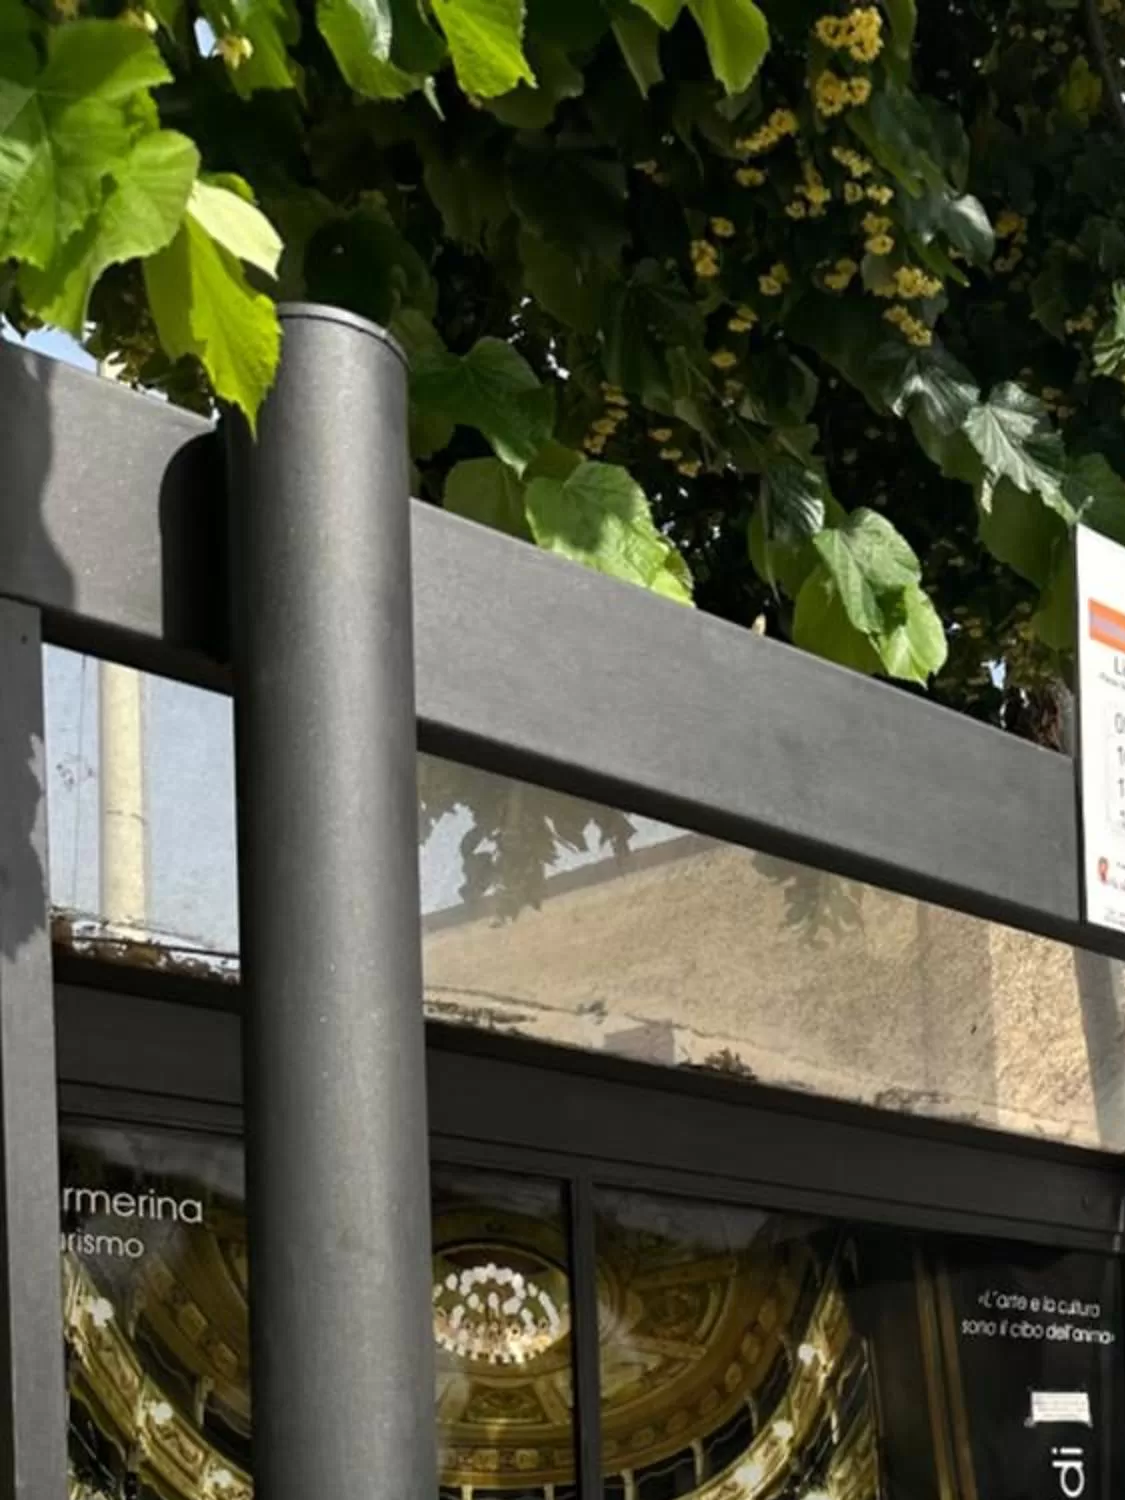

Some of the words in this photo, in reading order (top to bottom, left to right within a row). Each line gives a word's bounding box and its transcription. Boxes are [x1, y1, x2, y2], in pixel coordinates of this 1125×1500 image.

[1030, 1298, 1040, 1312] e
[1043, 1296, 1056, 1312] la
[1058, 1299, 1100, 1318] cultura
[962, 1319, 996, 1336] sono
[1001, 1319, 1008, 1336] il
[1010, 1321, 1044, 1339] cibo
